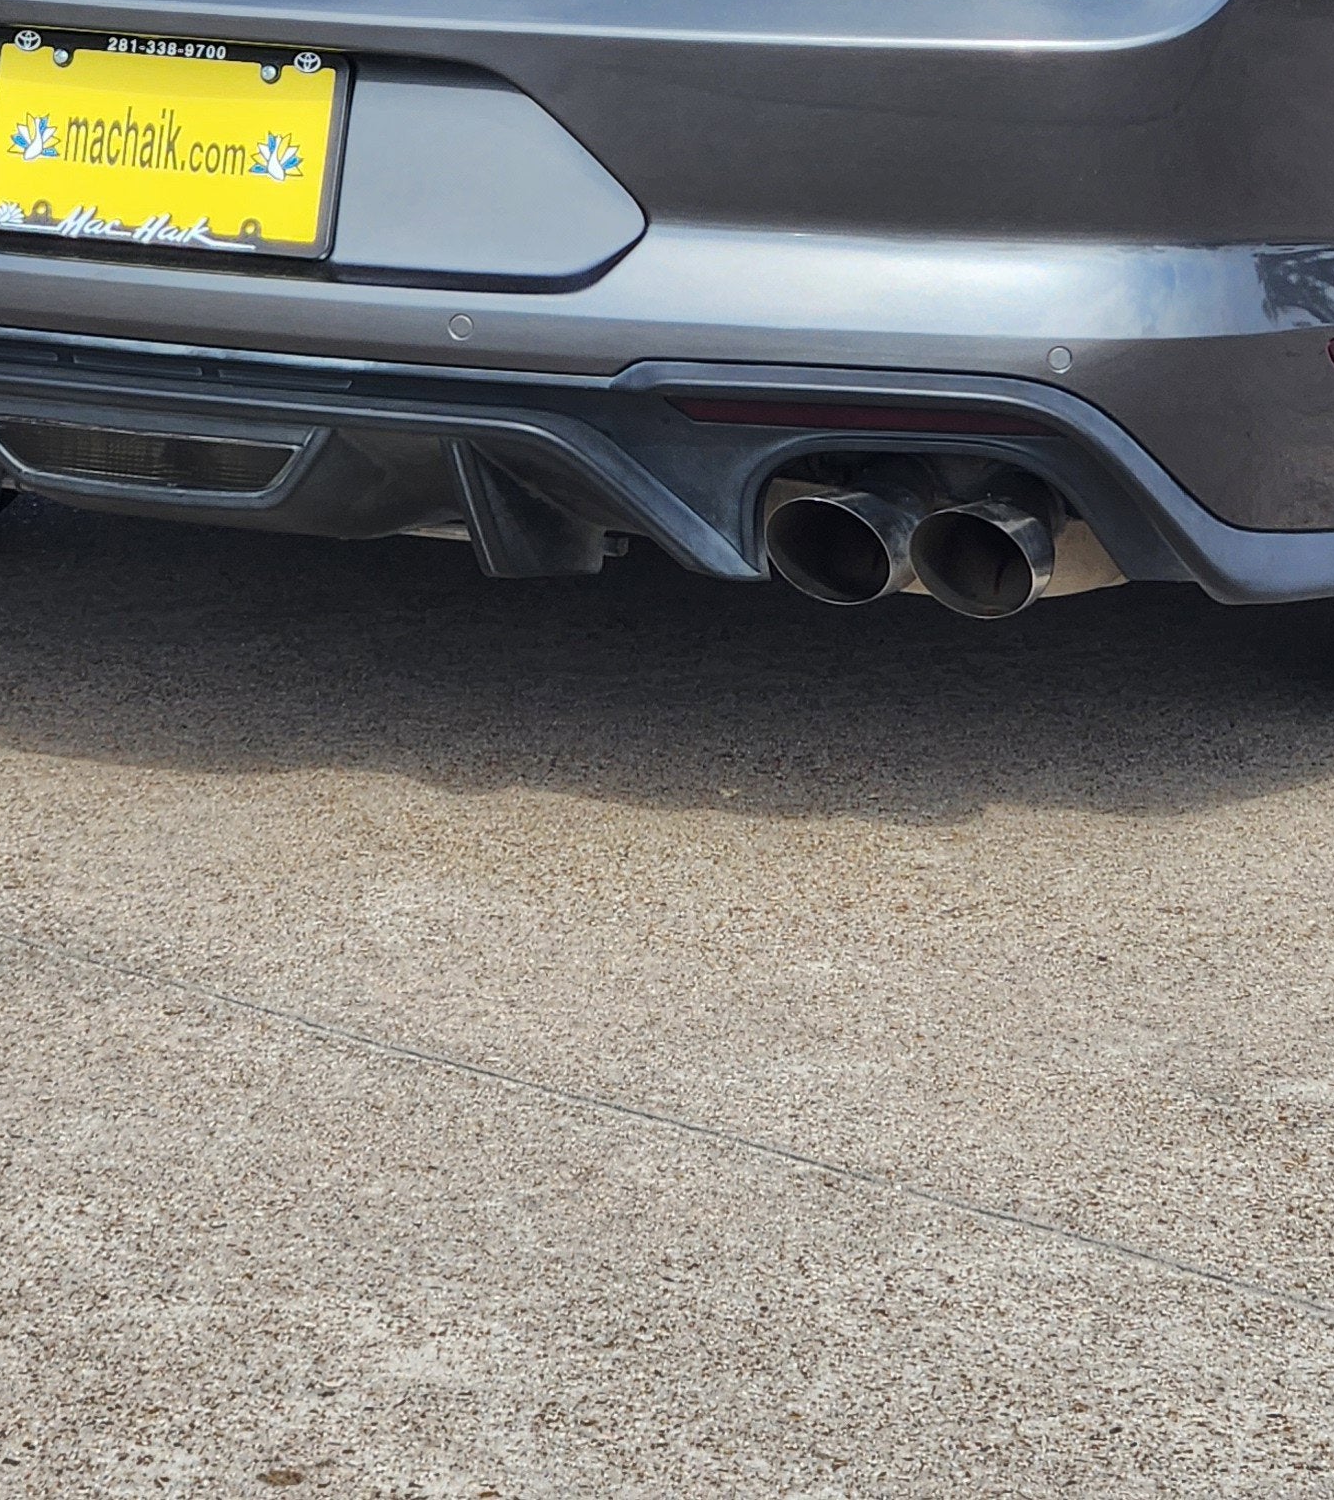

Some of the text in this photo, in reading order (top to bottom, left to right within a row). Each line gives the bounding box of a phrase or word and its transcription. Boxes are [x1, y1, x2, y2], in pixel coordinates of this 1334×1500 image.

[107, 37, 227, 60] 281-338-9700
[63, 106, 247, 176] machaik.com
[56, 204, 217, 246] Mac Haik
